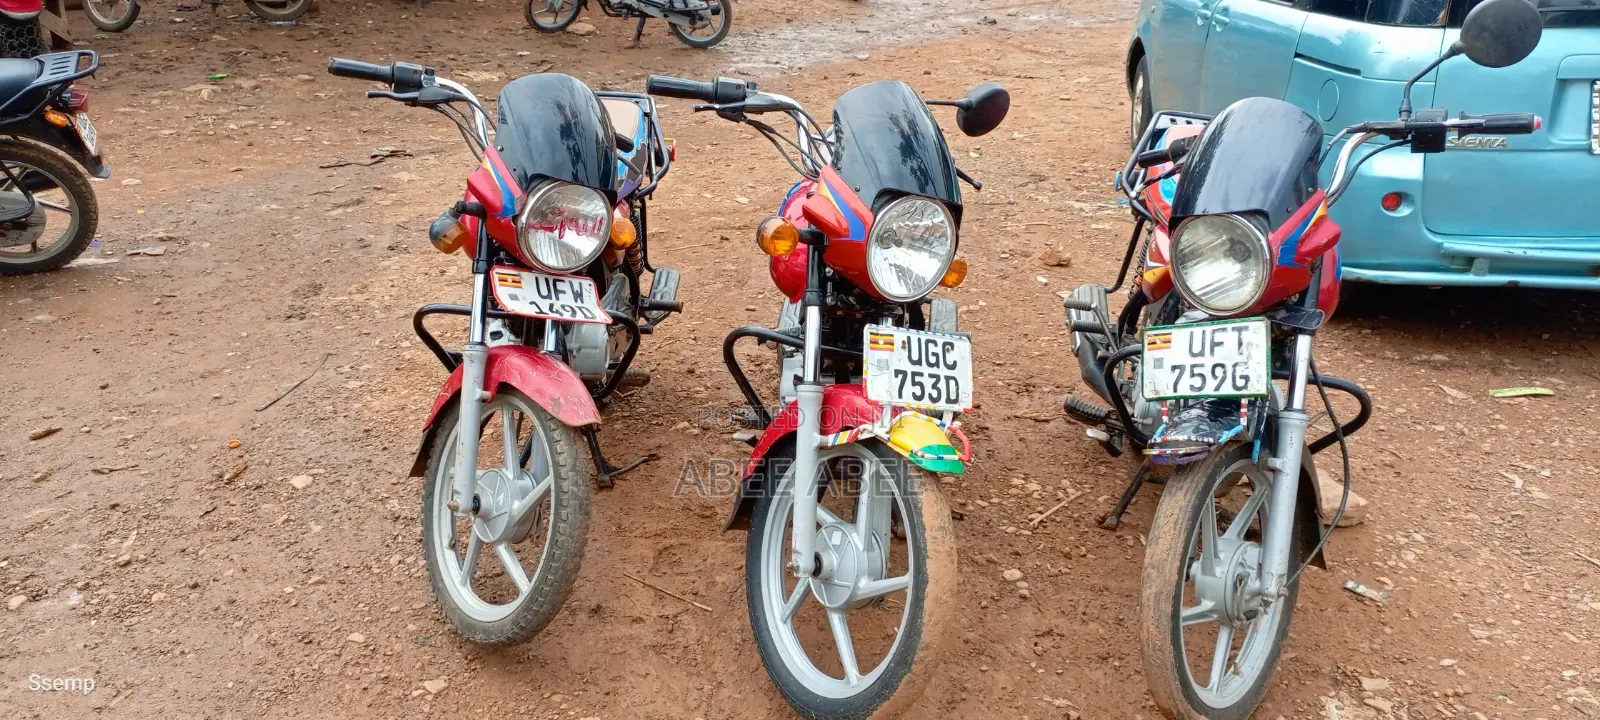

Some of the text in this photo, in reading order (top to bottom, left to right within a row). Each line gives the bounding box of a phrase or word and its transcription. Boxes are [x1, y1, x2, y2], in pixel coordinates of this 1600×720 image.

[1446, 136, 1508, 149] SIENTA
[534, 276, 585, 304] UFW
[528, 300, 598, 320] 149D
[906, 335, 958, 371] UGC
[1188, 325, 1250, 358] UFT
[893, 368, 960, 405] 753D
[1170, 362, 1251, 394] 759G
